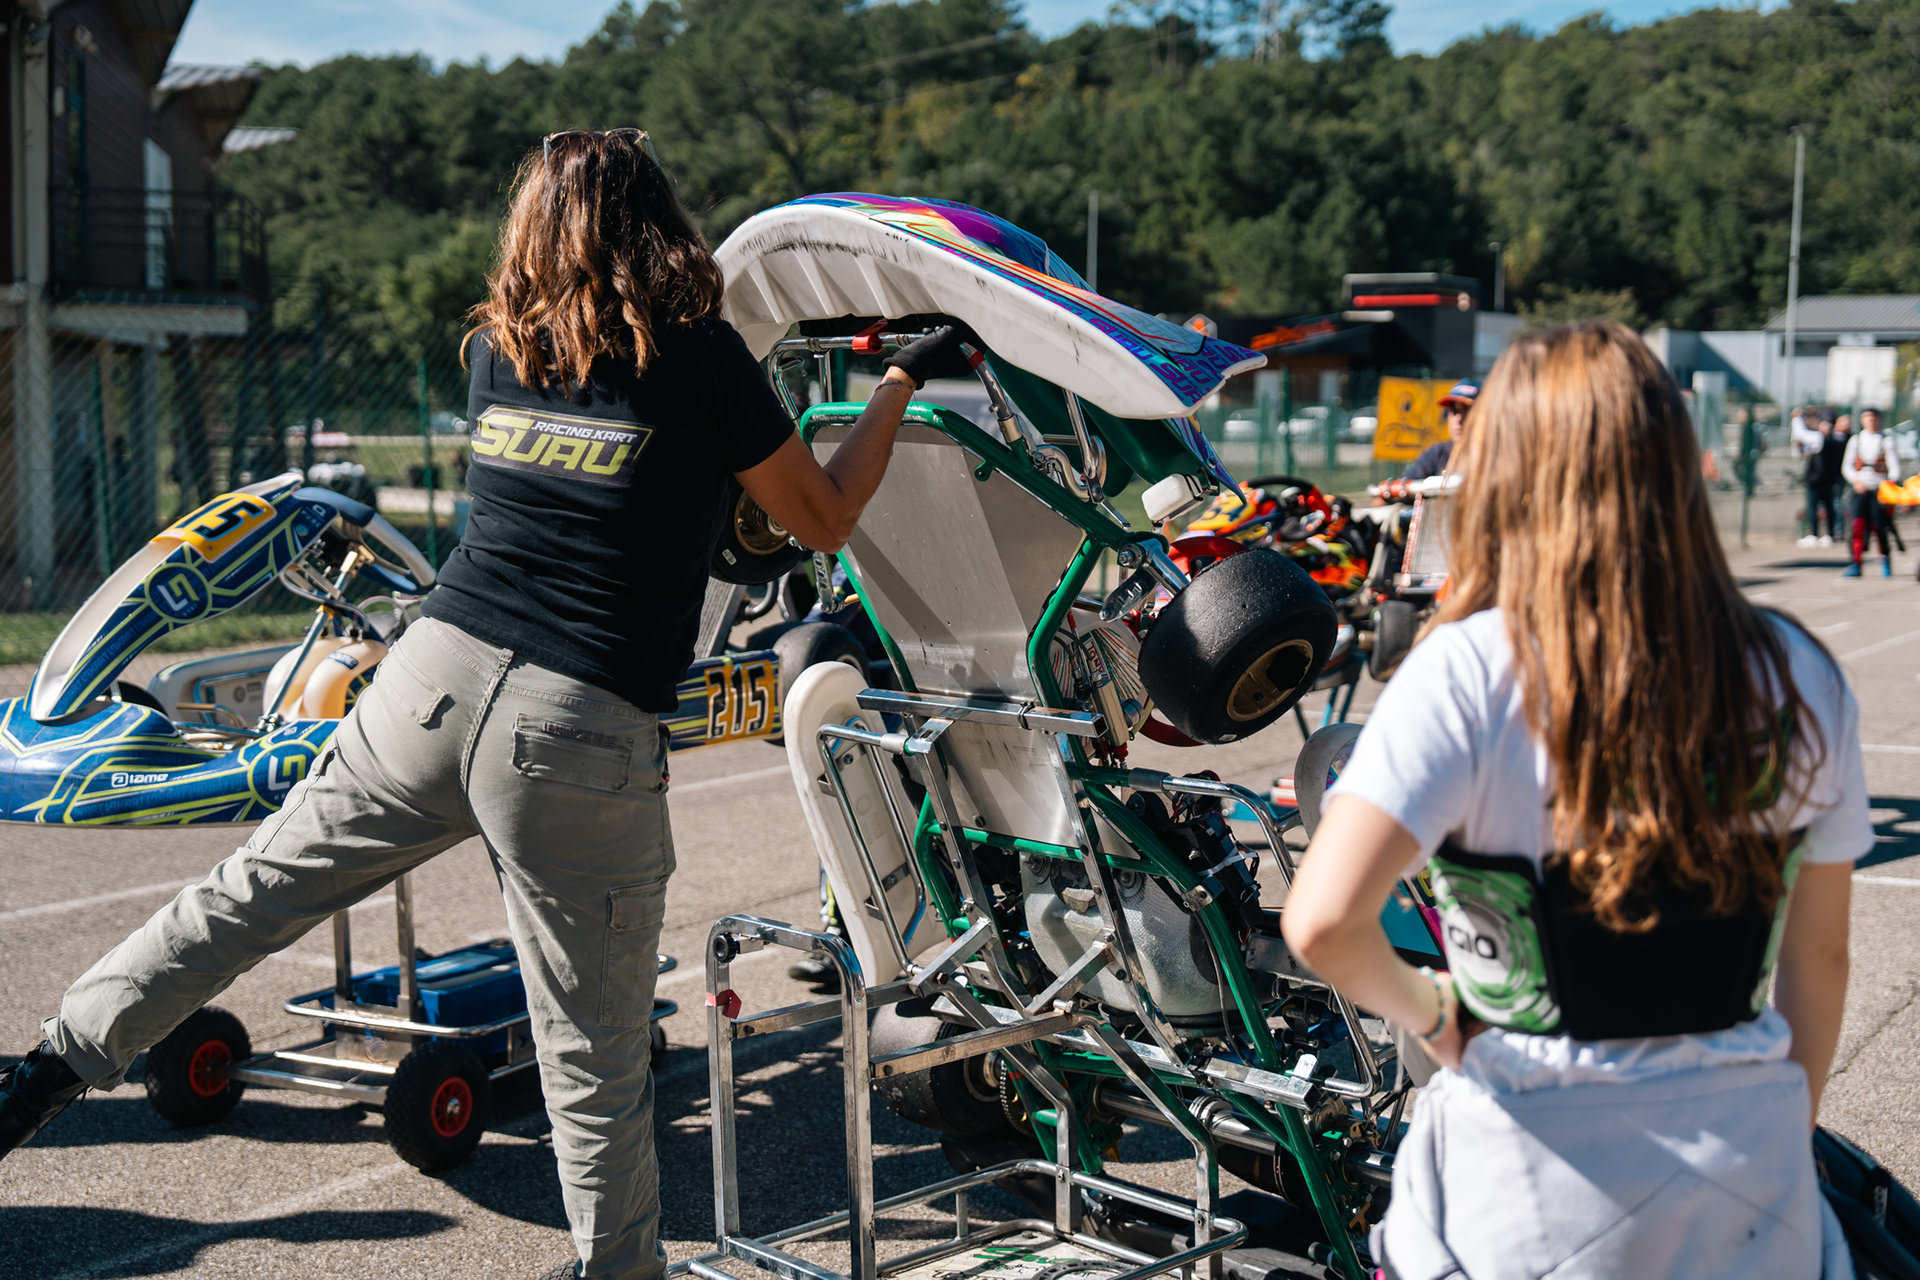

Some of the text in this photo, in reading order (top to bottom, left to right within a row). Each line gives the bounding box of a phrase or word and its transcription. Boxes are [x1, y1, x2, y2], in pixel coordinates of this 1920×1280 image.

[471, 414, 632, 475] SUAU
[531, 421, 637, 443] RACING KART
[707, 663, 769, 740] 215
